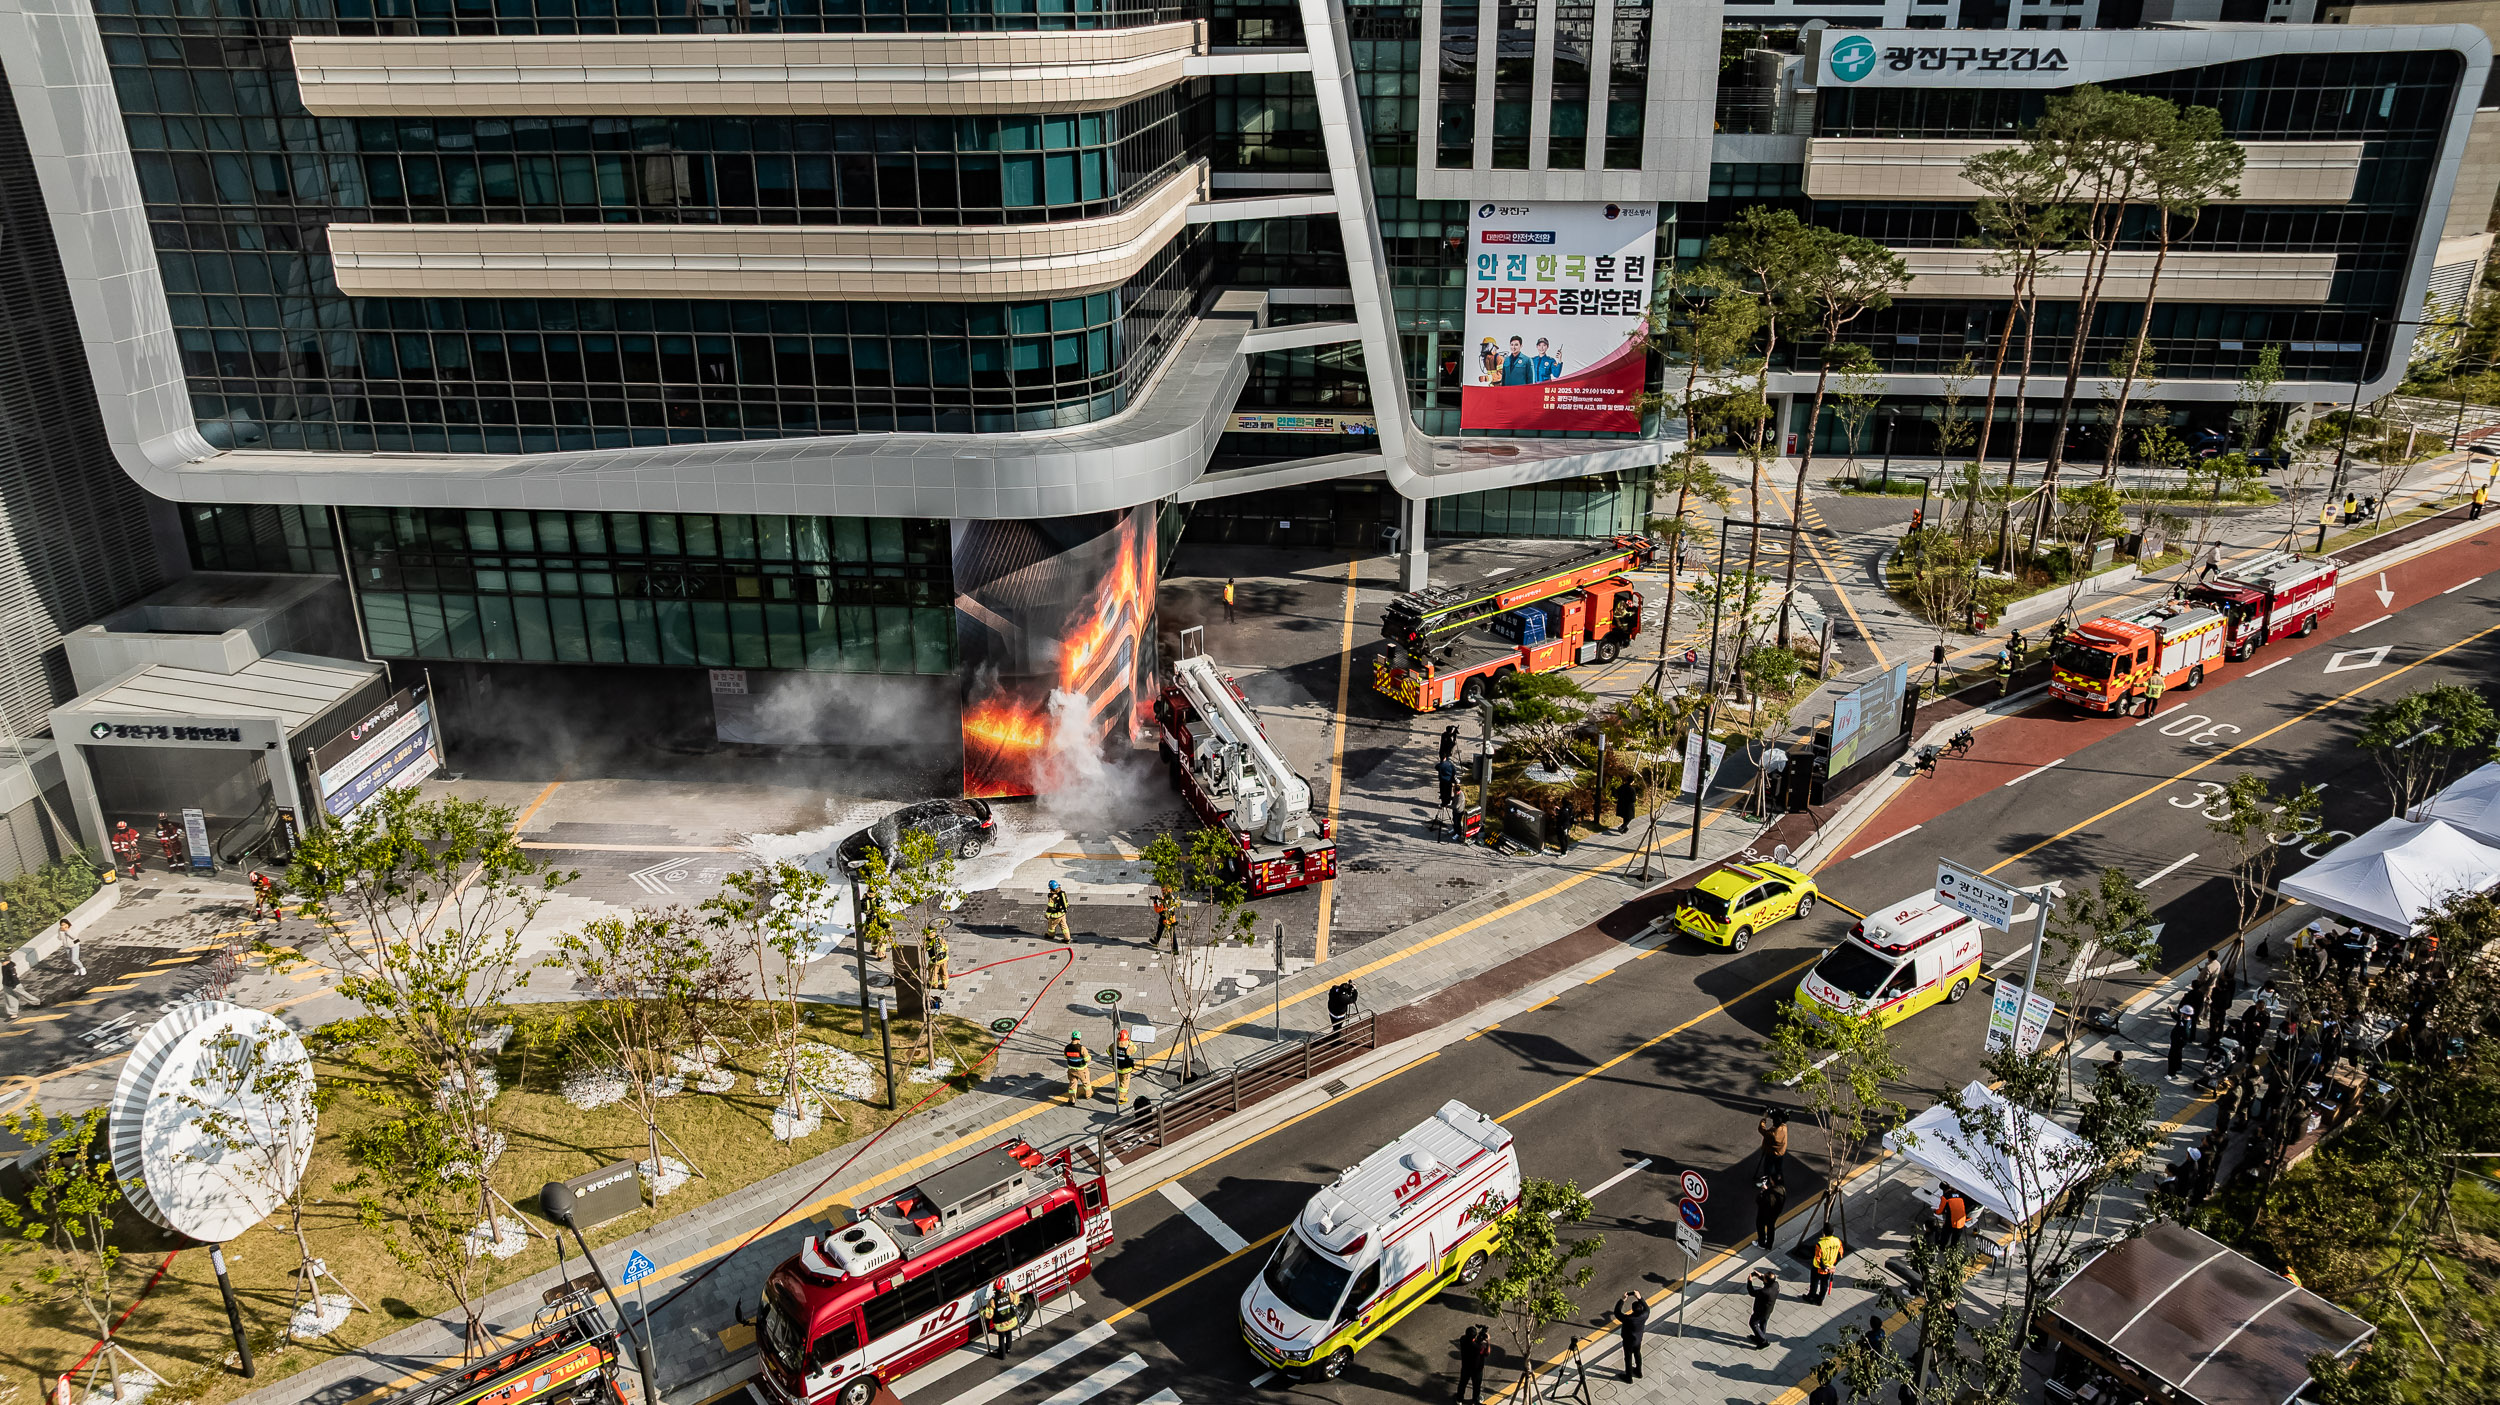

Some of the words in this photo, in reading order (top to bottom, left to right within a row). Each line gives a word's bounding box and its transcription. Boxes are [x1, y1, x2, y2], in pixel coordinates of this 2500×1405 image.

[1884, 46, 2069, 72] 광진구보건소
[1498, 207, 1530, 216] 광진구
[1621, 207, 1651, 217] 광진소방서
[1486, 233, 1511, 241] 대한민국
[1476, 288, 1642, 316] 긴급구조종합훈련
[1277, 417, 1333, 427] 안전한국훈련
[1558, 578, 1571, 588] 53M
[2205, 633, 2220, 649] 119
[1540, 647, 1554, 659] 119
[1838, 709, 1852, 731] 119
[112, 724, 169, 740] 광진구청
[172, 726, 242, 742] 통합민원실
[2159, 714, 2242, 746] 30
[1957, 891, 1990, 909] Gwangjin-gu
[1990, 905, 2006, 915] Office
[1958, 880, 2009, 909] 광진구청
[1753, 906, 1767, 920] 119
[1894, 911, 1909, 922] 119
[1956, 941, 1970, 959] 119
[1994, 998, 2017, 1017] 안전
[1991, 1013, 2014, 1032] 한국
[1393, 1170, 1422, 1200] 119
[1687, 1178, 1702, 1196] 30
[1087, 1218, 1109, 1238] 119
[1679, 1225, 1700, 1242] 견인지역
[918, 1301, 960, 1340] 119
[555, 1356, 590, 1377] 18M
